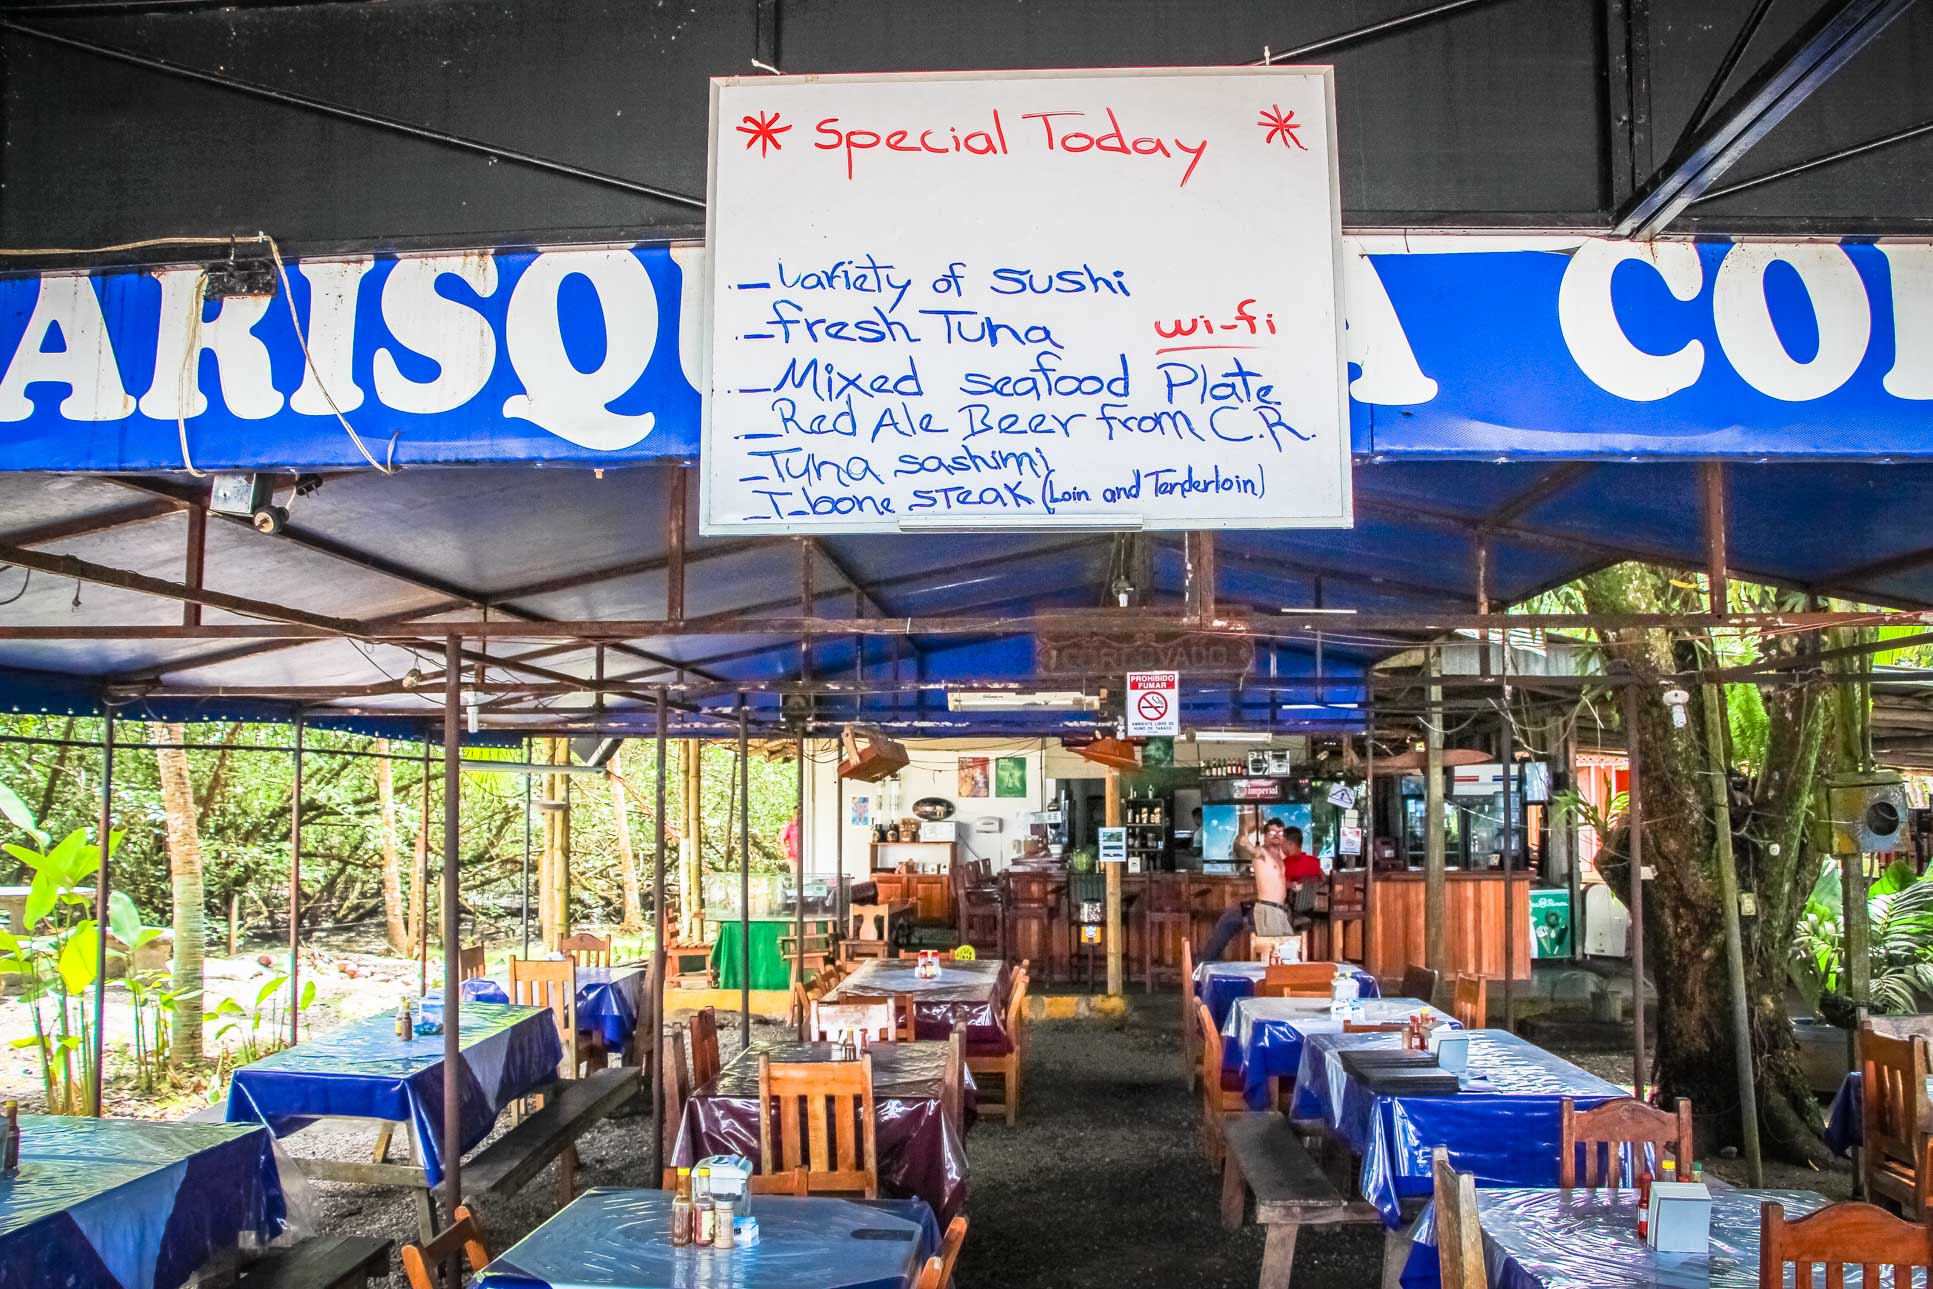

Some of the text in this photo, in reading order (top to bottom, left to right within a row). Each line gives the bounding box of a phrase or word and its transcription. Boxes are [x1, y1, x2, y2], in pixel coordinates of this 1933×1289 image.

[814, 106, 1208, 188] Special Today
[777, 253, 912, 314] Variety
[932, 262, 967, 297] of
[918, 309, 1065, 349] Tuna
[773, 351, 1282, 406] Mixed seafood Plate
[771, 393, 857, 438] Red
[871, 401, 949, 443] Ale
[957, 404, 1087, 442] Beer
[747, 447, 885, 487] Tuna
[1102, 469, 1142, 503] and
